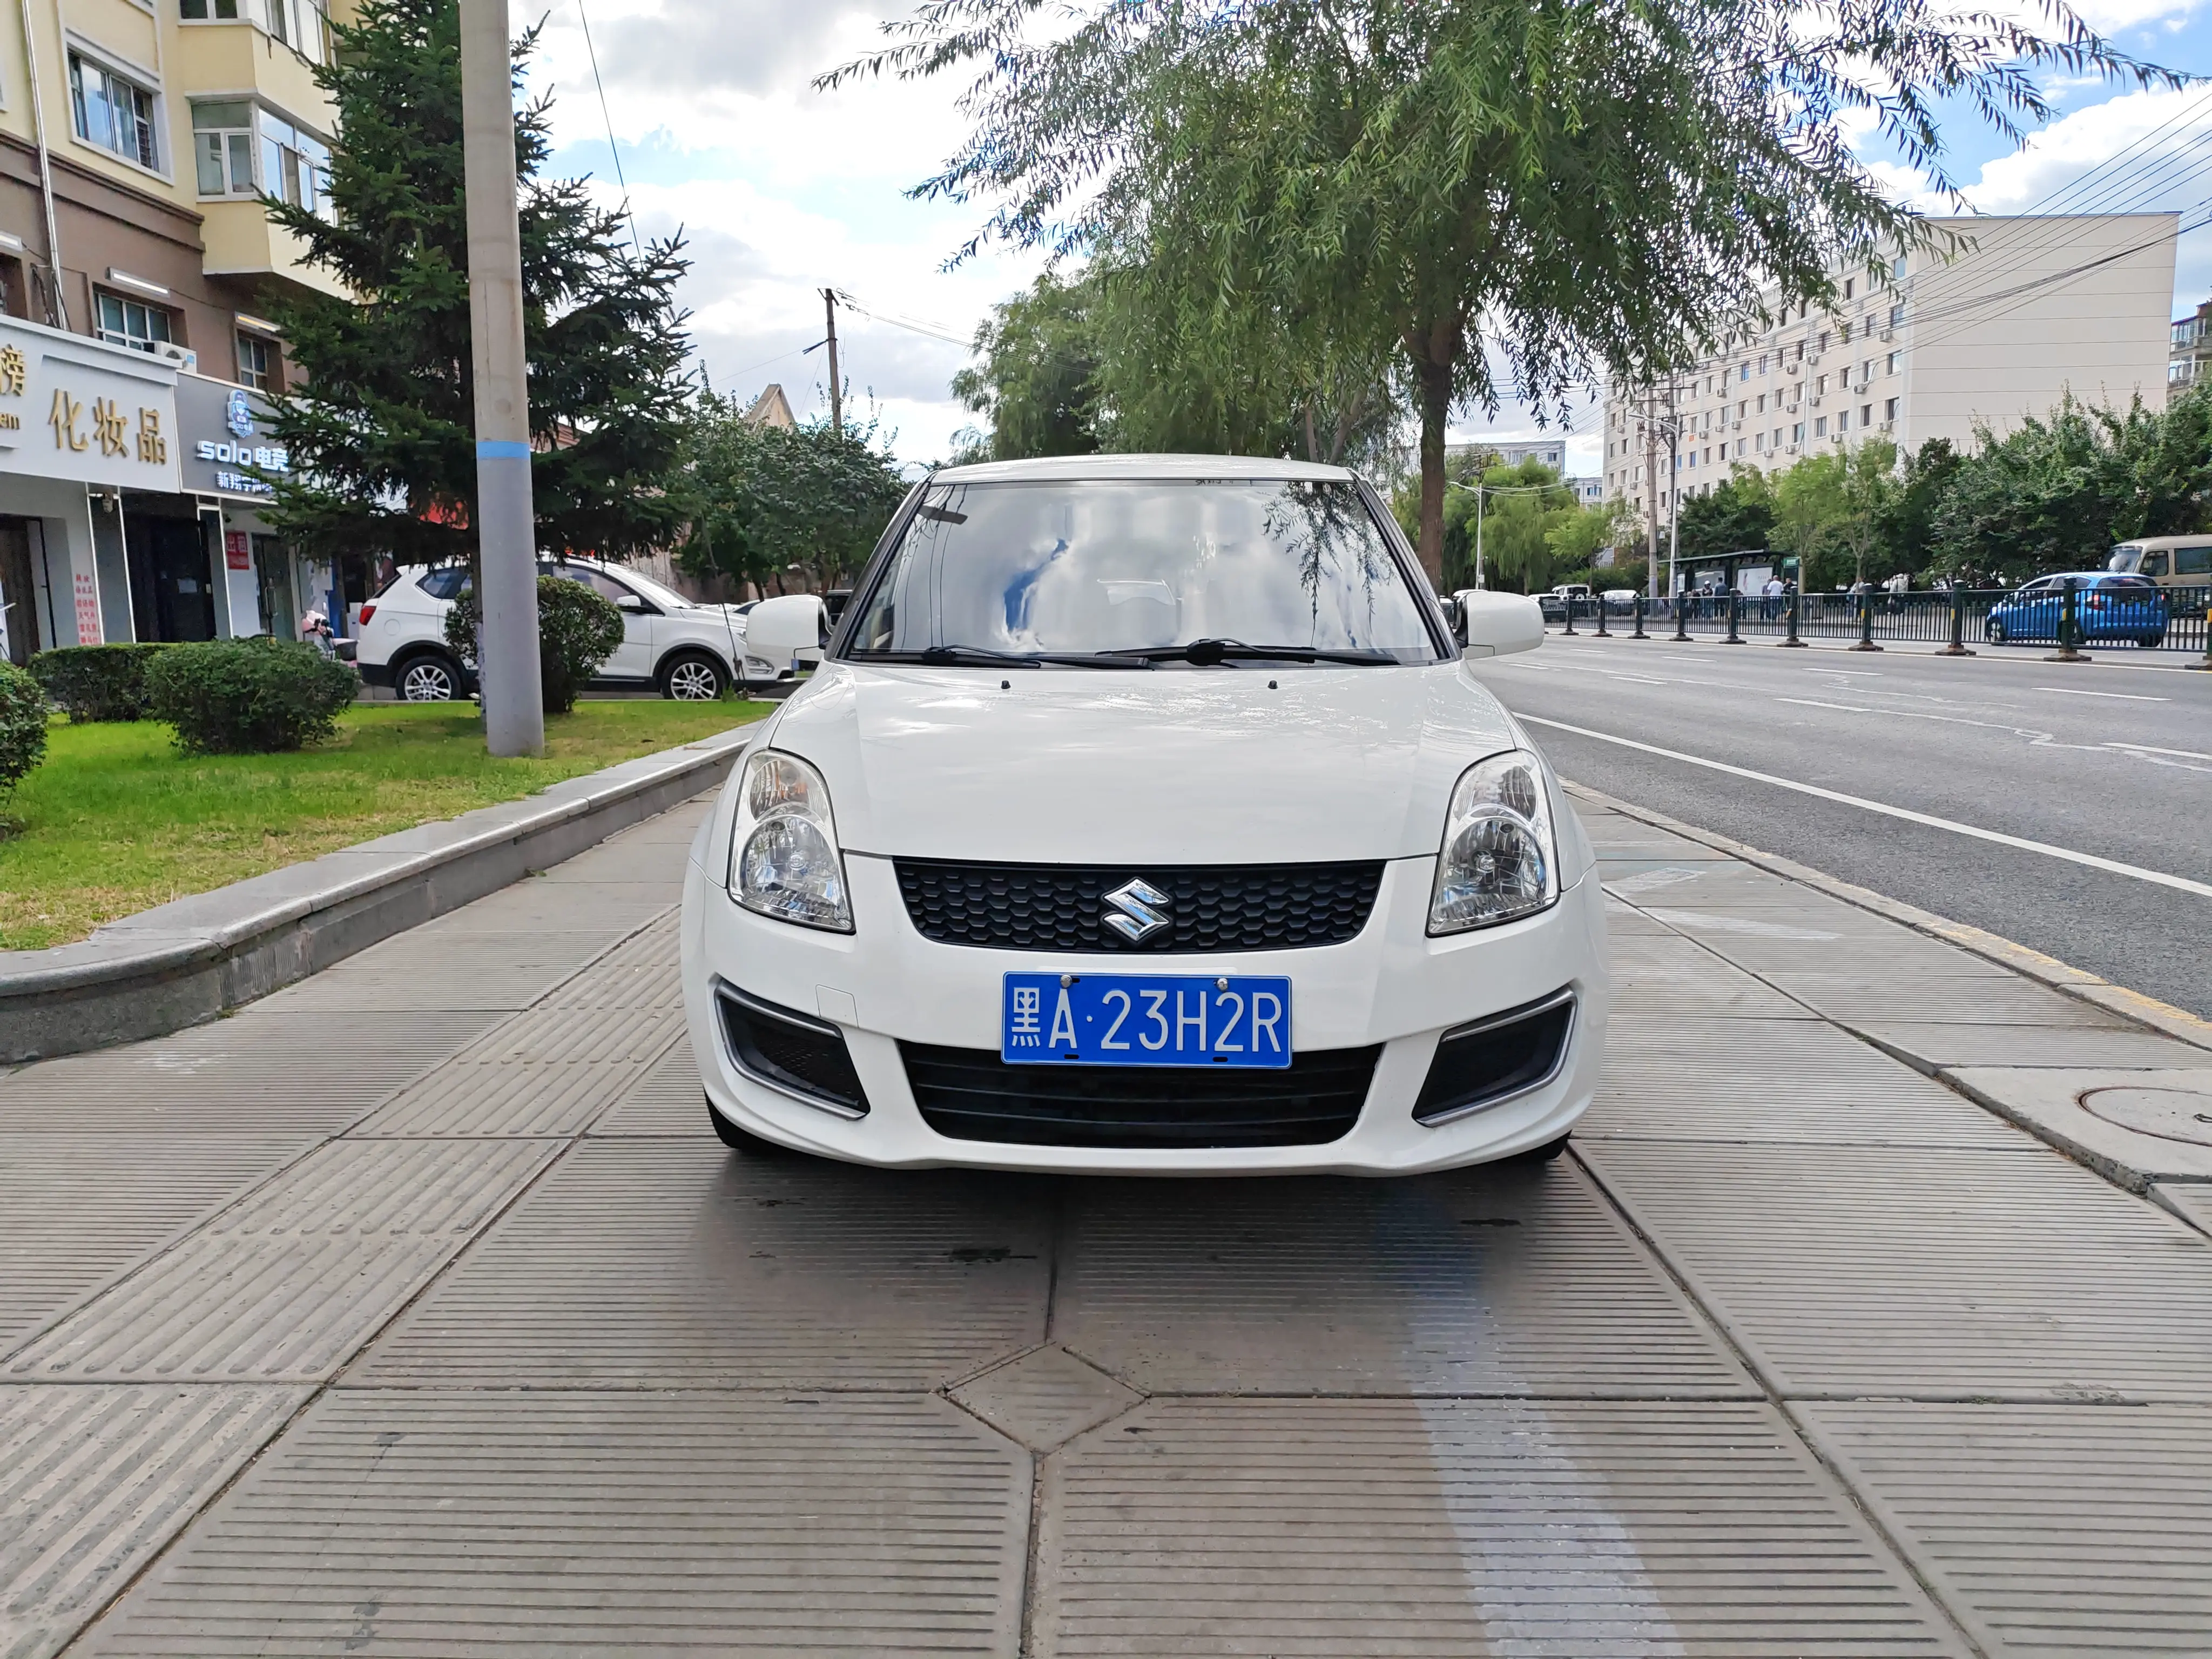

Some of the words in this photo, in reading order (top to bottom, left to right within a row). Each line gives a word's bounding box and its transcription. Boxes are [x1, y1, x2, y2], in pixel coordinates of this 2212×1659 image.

[48, 388, 167, 466] 化妆品
[197, 440, 252, 466] solo
[254, 446, 290, 472] 电竞
[1011, 987, 1282, 1053] 黑A·23H2R
